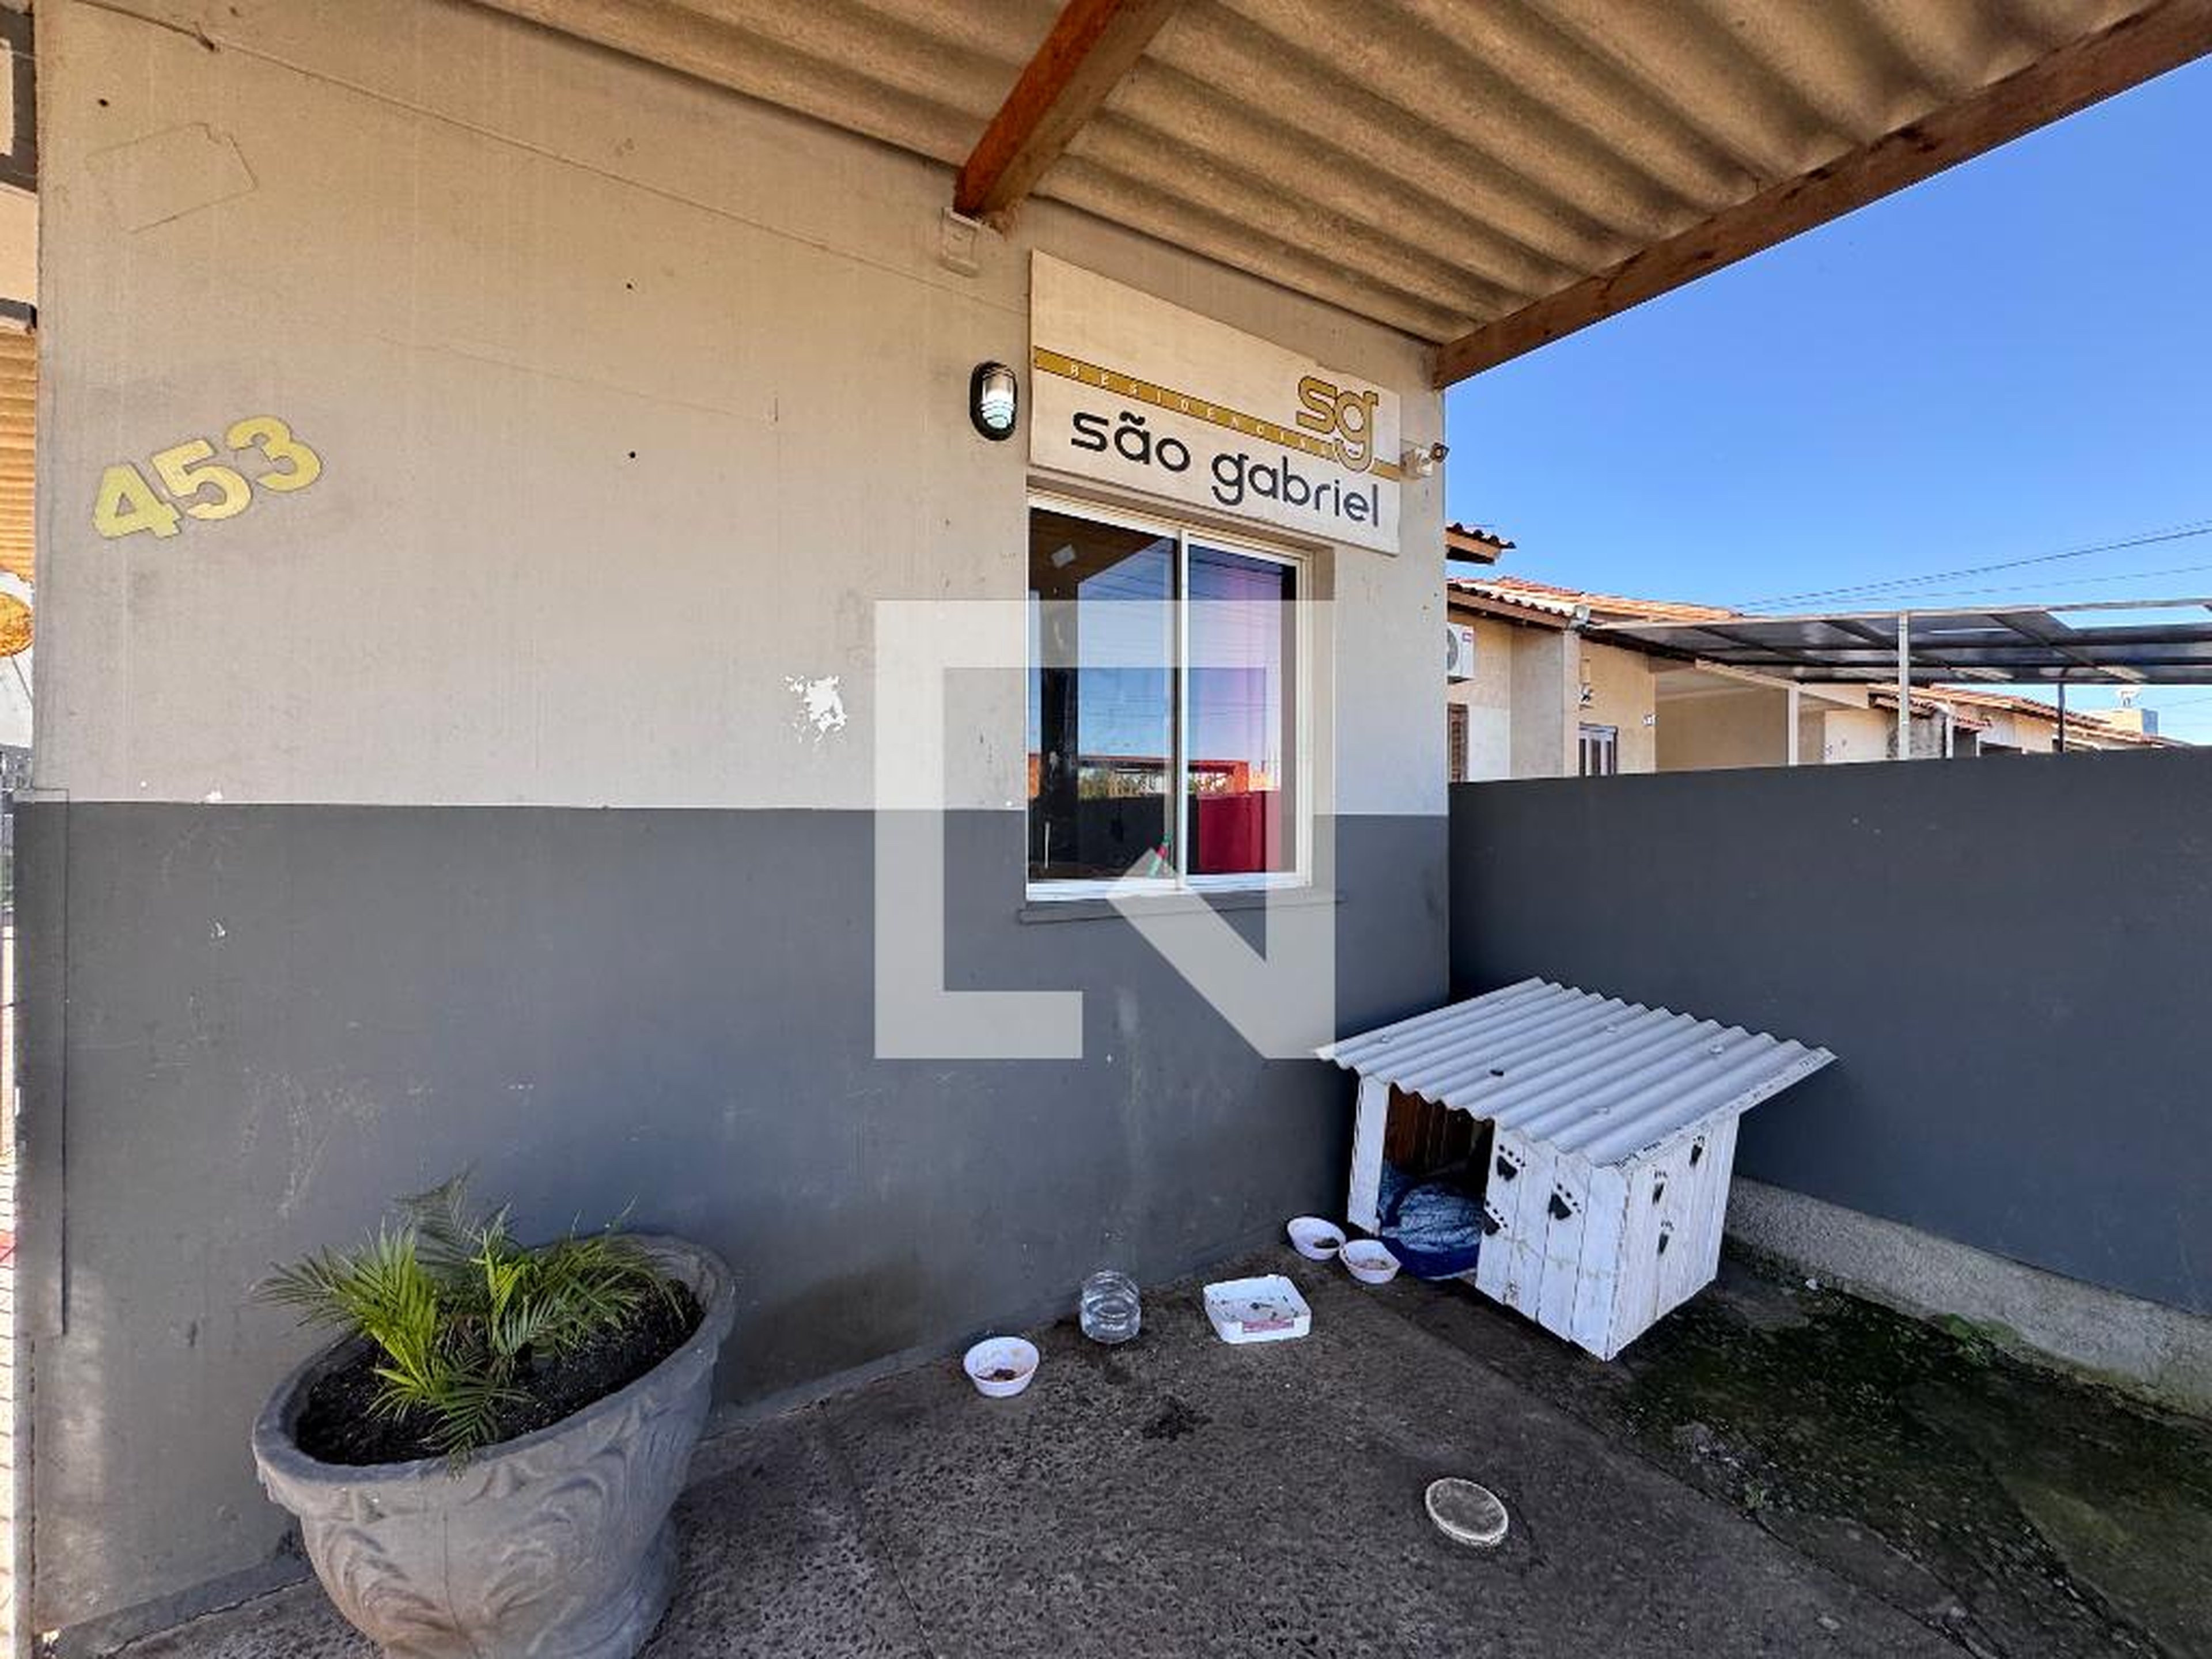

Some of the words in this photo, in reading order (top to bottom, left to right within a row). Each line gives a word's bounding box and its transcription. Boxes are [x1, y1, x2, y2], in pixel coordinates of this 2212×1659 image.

[93, 415, 322, 539] 453
[1070, 410, 1191, 472] são
[1211, 452, 1379, 527] gabriel
[1296, 375, 1378, 471] sg
